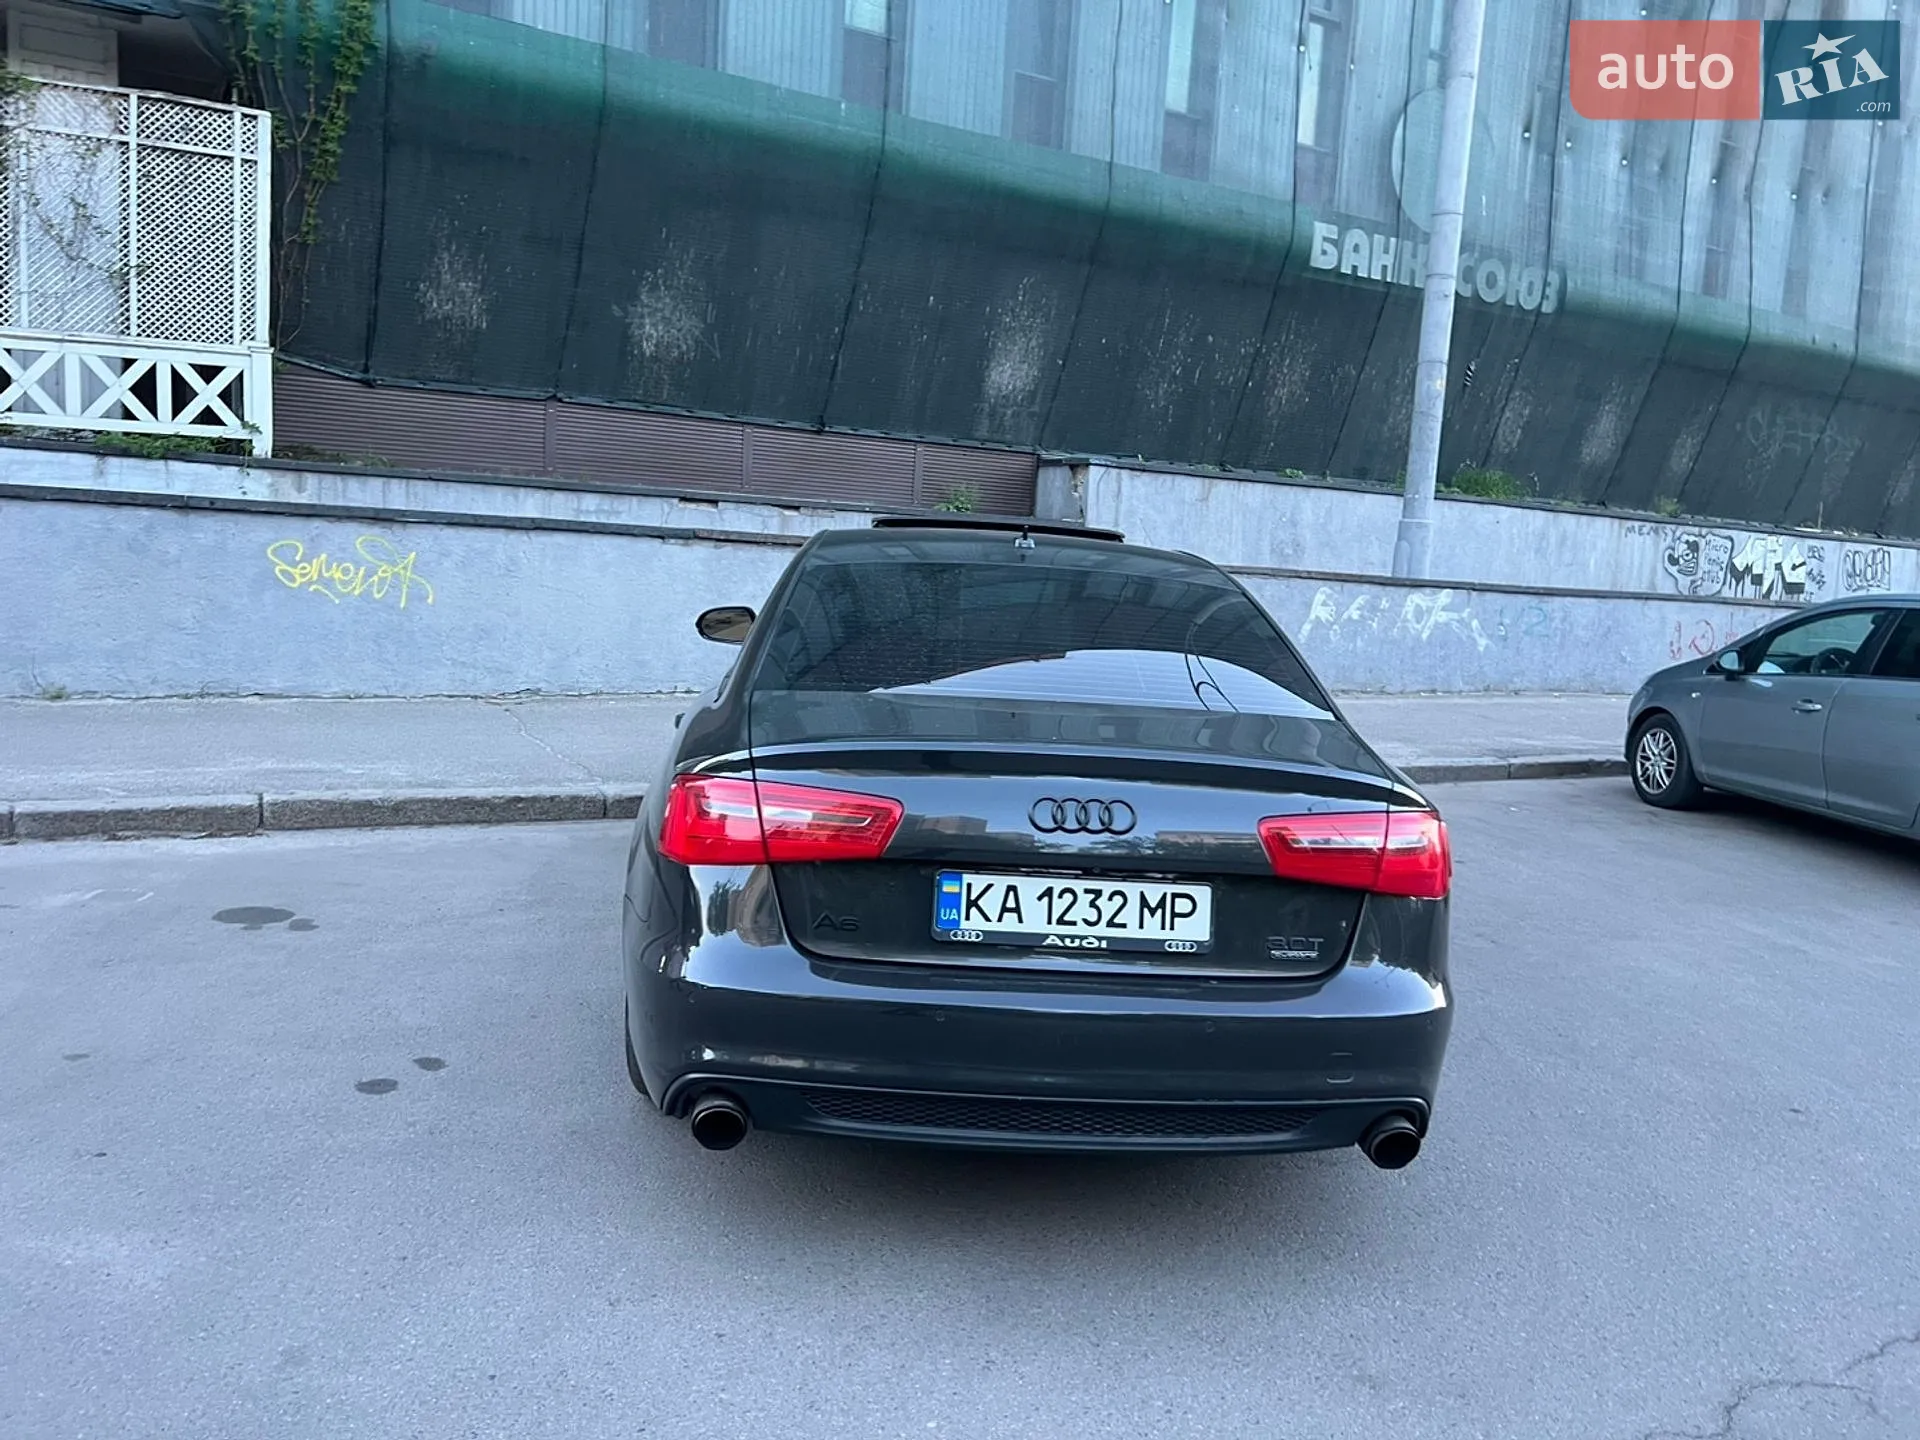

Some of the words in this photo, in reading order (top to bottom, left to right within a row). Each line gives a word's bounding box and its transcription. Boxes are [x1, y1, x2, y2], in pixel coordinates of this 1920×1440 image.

[964, 882, 1024, 924] KA
[1036, 886, 1129, 928] 1232
[1138, 890, 1197, 931] MP
[941, 908, 958, 921] UA
[1041, 935, 1107, 948] Audi
